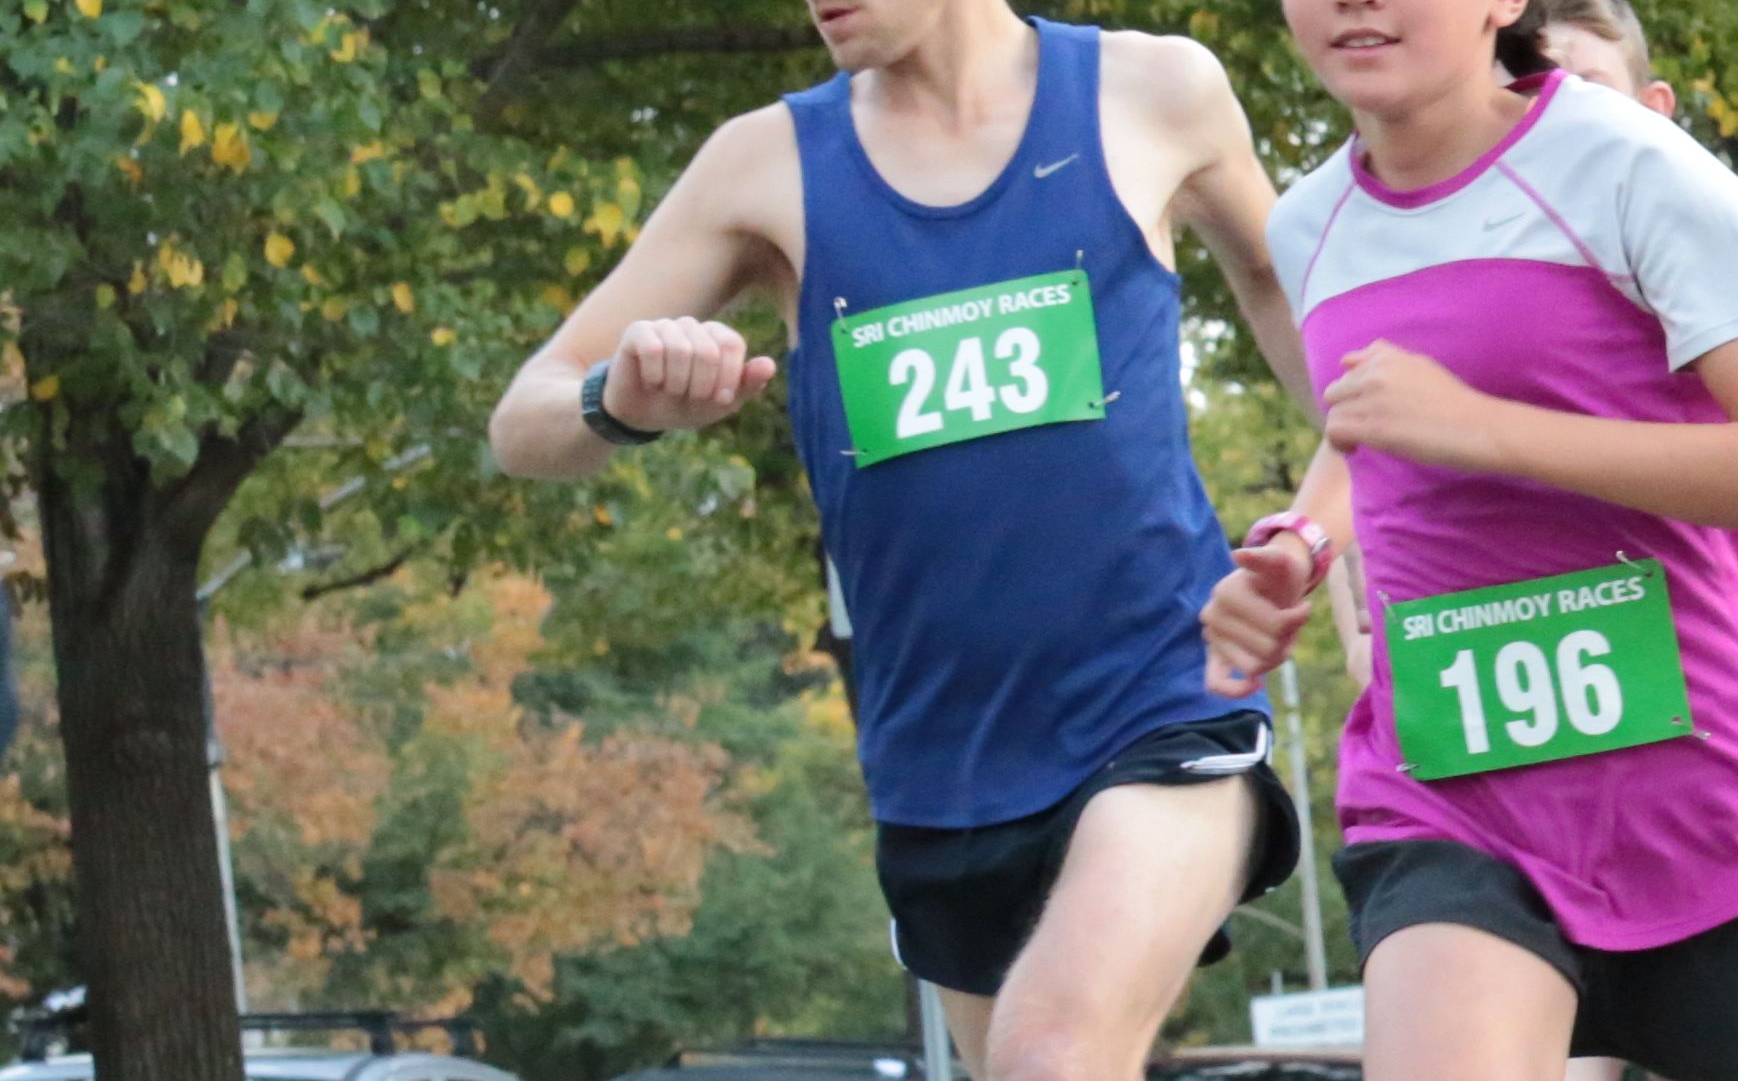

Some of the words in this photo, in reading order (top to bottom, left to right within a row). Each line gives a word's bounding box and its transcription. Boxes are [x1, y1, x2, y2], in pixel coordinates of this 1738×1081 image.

[853, 322, 884, 348] SRI
[887, 298, 993, 337] CHINMOY
[998, 284, 1072, 308] RACES
[888, 326, 1049, 439] 243
[1403, 614, 1434, 640] SRI
[1437, 594, 1552, 634] CHINMOY
[1558, 576, 1646, 614] RACES
[1439, 629, 1623, 754] 196
